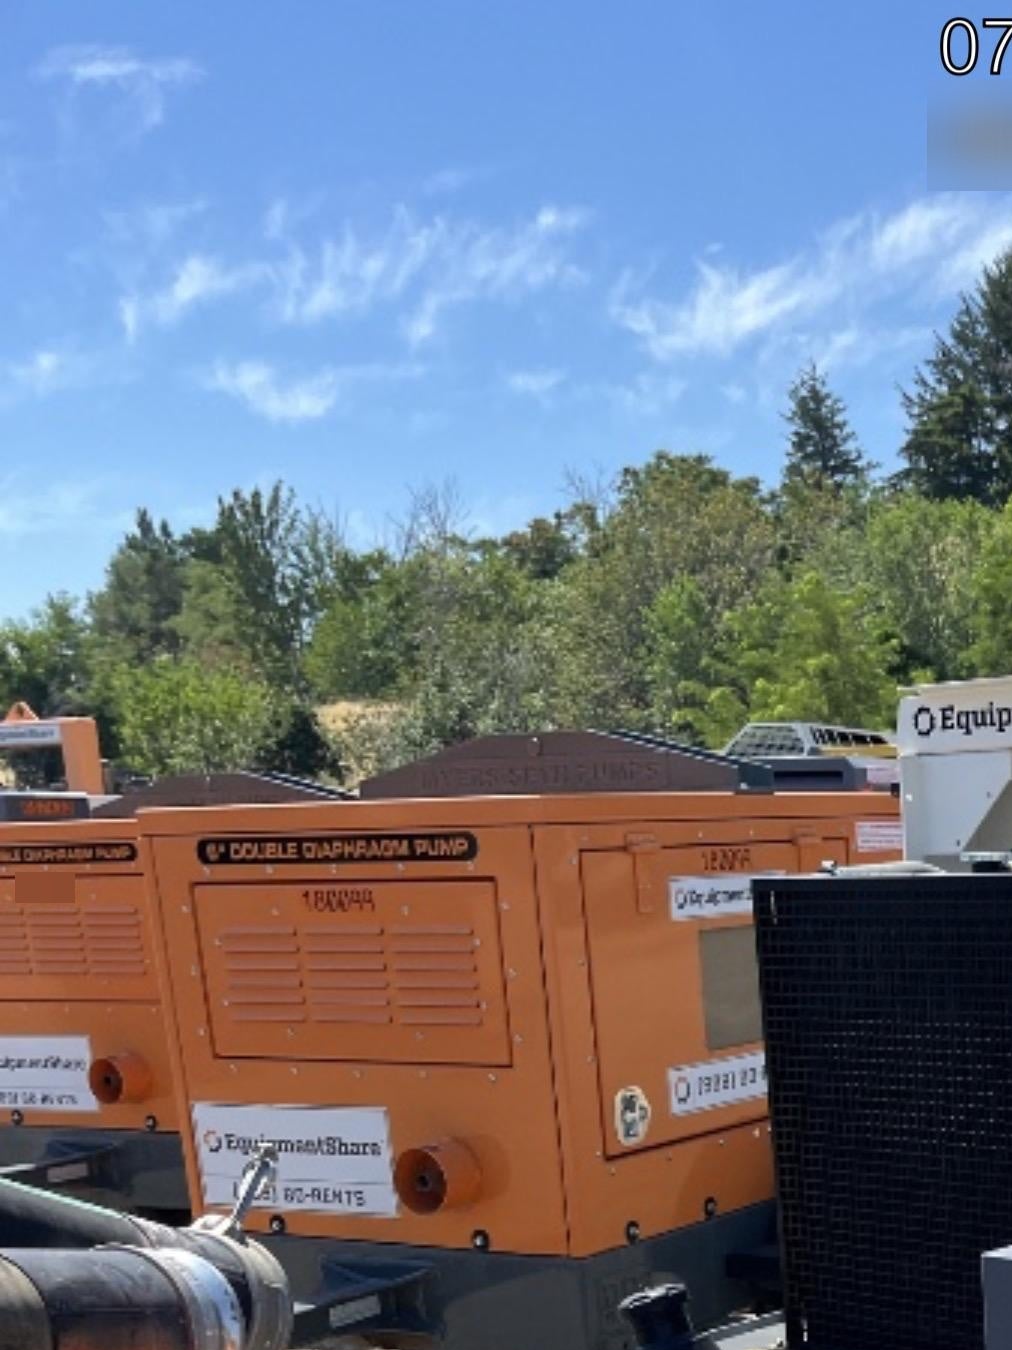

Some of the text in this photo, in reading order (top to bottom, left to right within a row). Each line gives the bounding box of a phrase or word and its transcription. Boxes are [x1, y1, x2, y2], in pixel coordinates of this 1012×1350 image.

[230, 842, 299, 859] DOUBLE
[302, 838, 410, 859] DIAPHRAGM
[414, 837, 469, 856] PUMP
